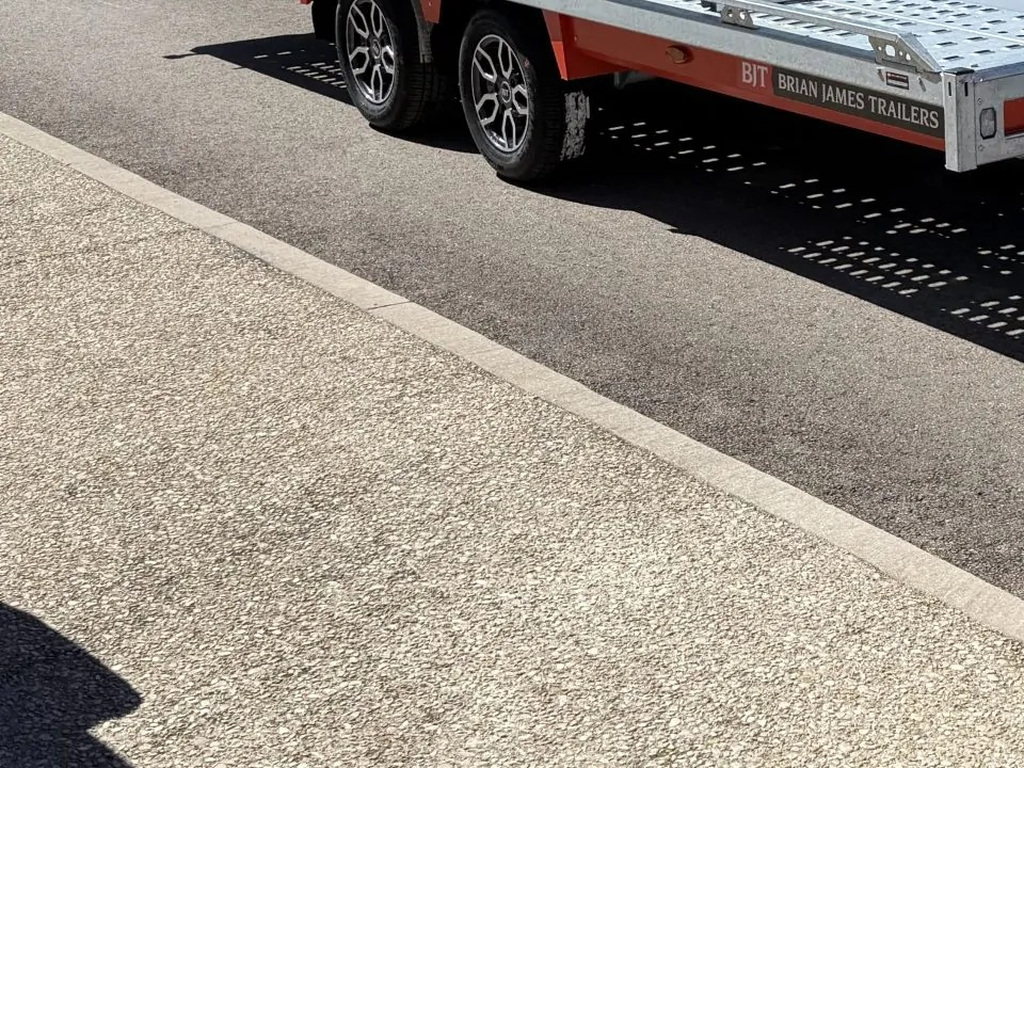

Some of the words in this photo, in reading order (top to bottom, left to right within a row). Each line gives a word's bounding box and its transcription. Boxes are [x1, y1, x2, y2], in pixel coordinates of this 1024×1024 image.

[741, 62, 768, 87] BJT
[778, 73, 818, 98] BRIAN
[822, 83, 865, 109] JAMES
[868, 95, 939, 128] TRAILERS
